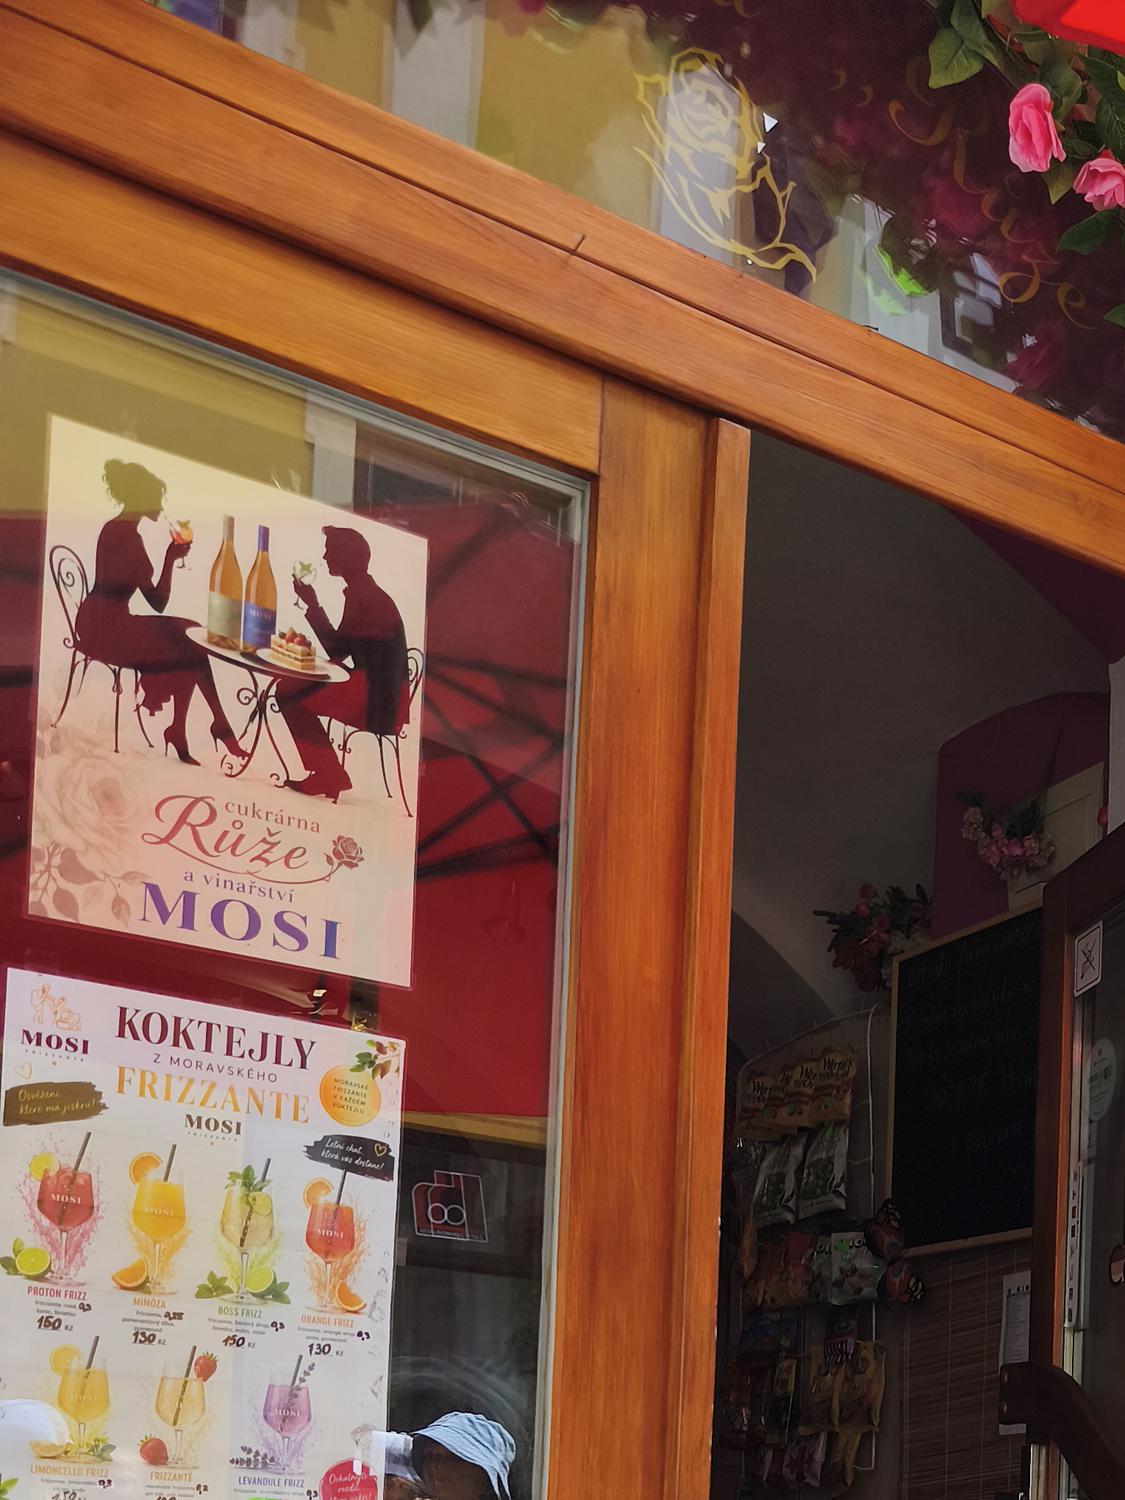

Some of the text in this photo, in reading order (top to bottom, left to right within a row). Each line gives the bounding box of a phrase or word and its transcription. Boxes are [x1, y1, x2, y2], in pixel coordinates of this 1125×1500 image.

[225, 801, 322, 834] cukrárna
[142, 794, 310, 871] Růže
[183, 870, 296, 904] a vinařství
[138, 882, 343, 960] MOSI
[21, 1028, 90, 1055] MOSI
[115, 1005, 318, 1070] KOKTEJLY
[152, 1053, 279, 1084] Z MORAVSKÉHO
[115, 1066, 311, 1124] FRIZZANTE
[184, 1114, 243, 1136] MOSI
[27, 1285, 88, 1301] PROTON FRIZZ
[218, 1306, 263, 1319] BOSS FRIZZ
[301, 1315, 355, 1329] ORANGE FRIZZ
[132, 1331, 157, 1344] 130
[308, 1343, 333, 1357] 130
[30, 1464, 84, 1477] LIMONCELLO
[238, 1476, 305, 1489] LEVANDULE FRIZZ
